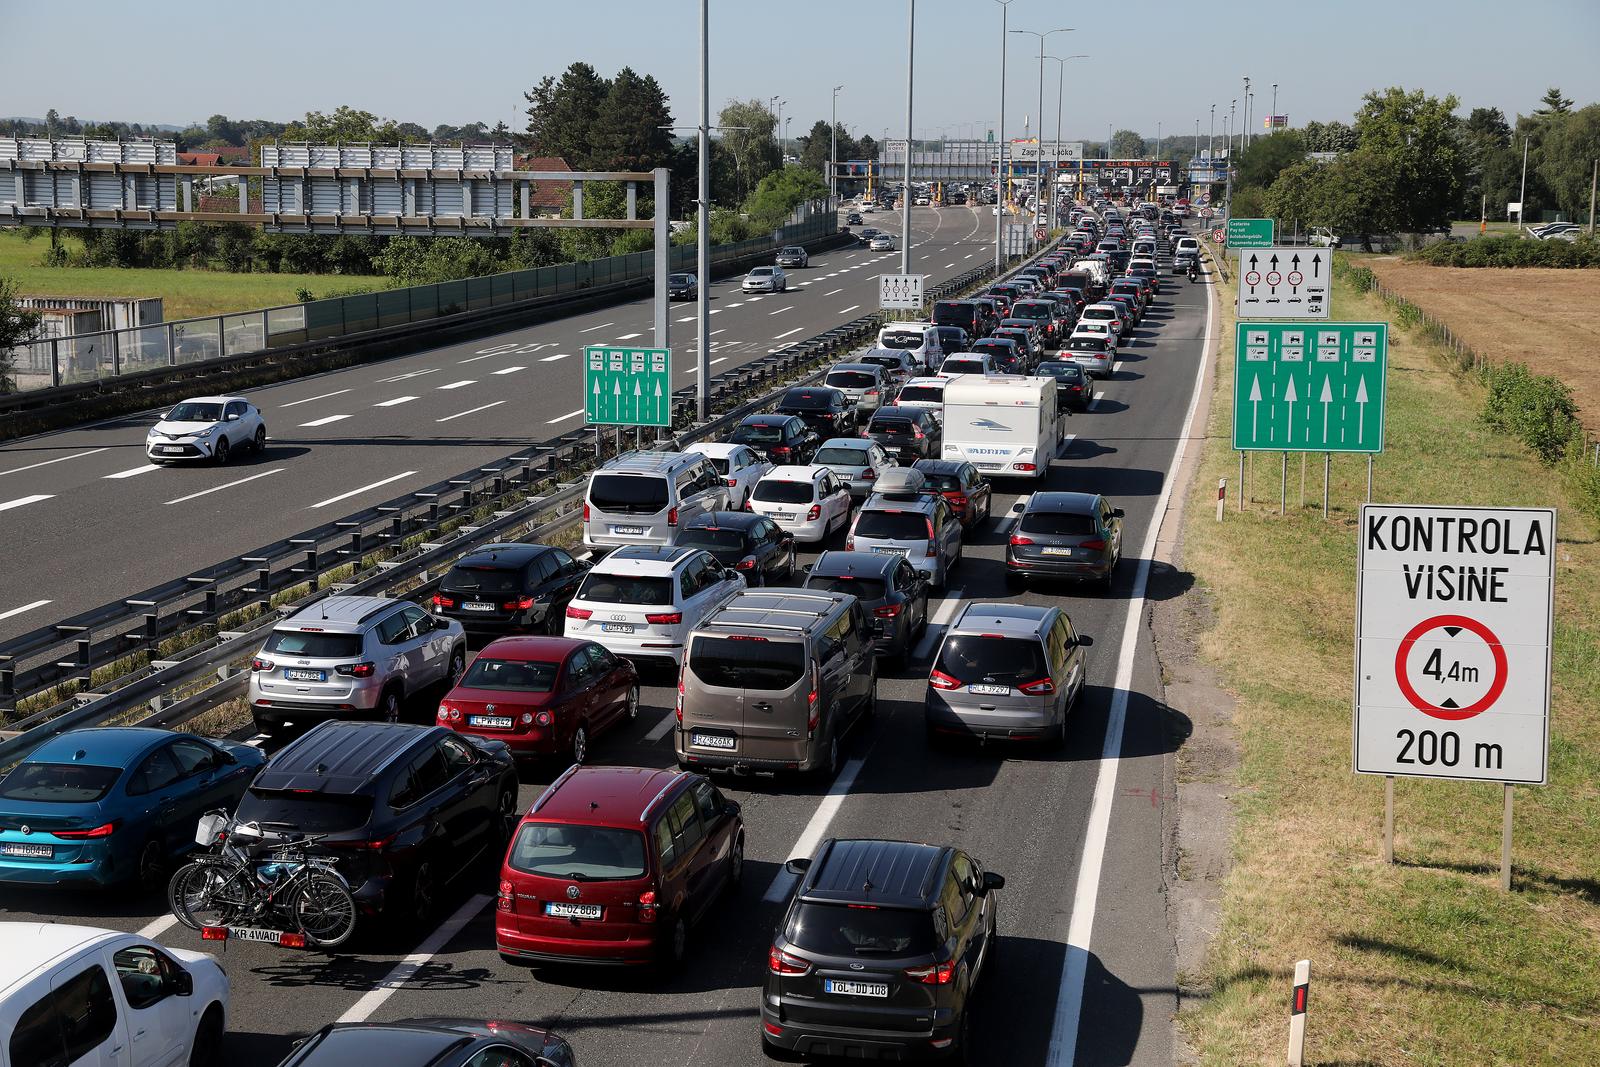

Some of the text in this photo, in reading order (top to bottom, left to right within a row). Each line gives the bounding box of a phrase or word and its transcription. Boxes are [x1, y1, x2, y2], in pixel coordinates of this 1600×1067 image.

[1368, 515, 1547, 556] KONTROLA
[1403, 563, 1510, 603] VISINE
[1422, 648, 1479, 684] 4,4m
[1396, 728, 1503, 770] 200 m
[580, 905, 597, 915] 808
[234, 929, 280, 941] KR 4WA01
[856, 983, 867, 994] DD
[869, 984, 886, 996] 108
